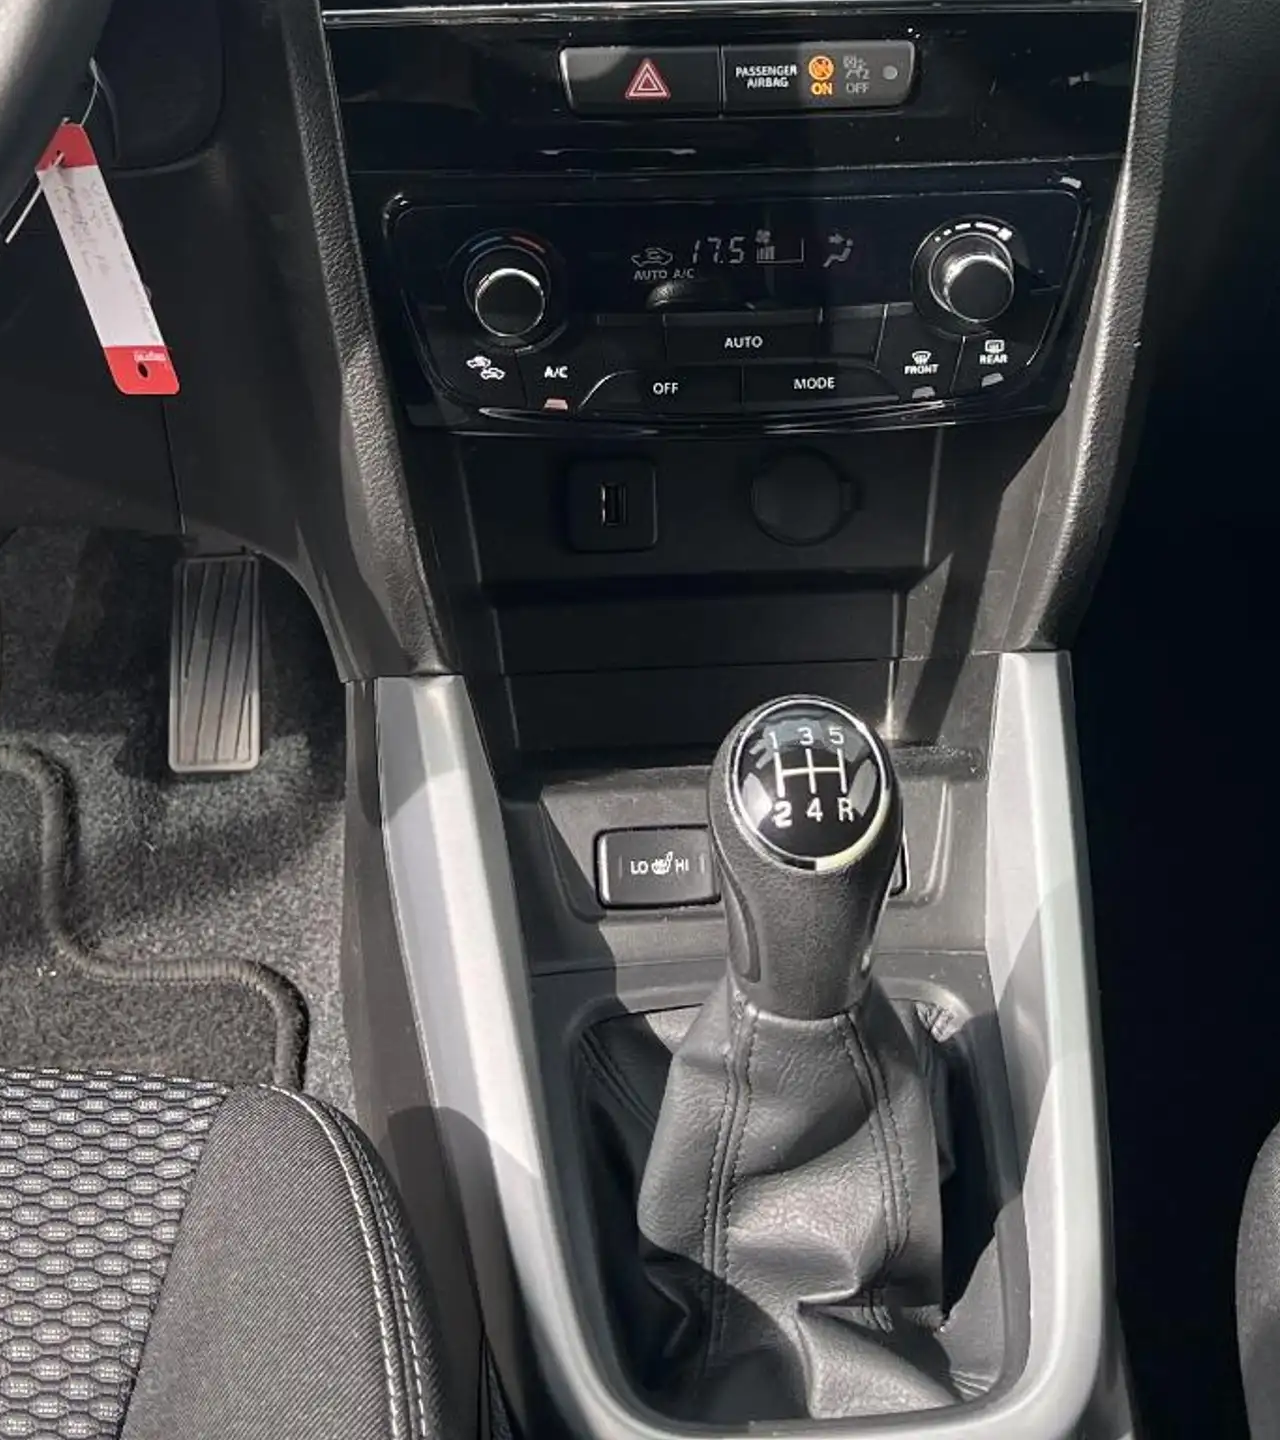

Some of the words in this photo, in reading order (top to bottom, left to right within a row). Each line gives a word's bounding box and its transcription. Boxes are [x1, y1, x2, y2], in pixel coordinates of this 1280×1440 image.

[735, 64, 798, 77] PASSENGER
[747, 76, 789, 89] AIRBAG
[811, 82, 833, 95] ON
[846, 82, 870, 94] OFF
[692, 236, 745, 264] 17.5
[634, 269, 668, 280] AUTO
[672, 268, 695, 279] A/C
[724, 336, 763, 349] AUTO
[980, 354, 1008, 364] REAR
[544, 365, 568, 378] A/C
[904, 364, 939, 375] FRONT
[653, 382, 678, 394] OFF
[793, 375, 836, 390] MODE
[768, 730, 779, 748] 1
[797, 727, 814, 745] 3
[828, 727, 844, 745] 5
[772, 800, 793, 827] 2
[806, 797, 823, 822] 4
[837, 798, 854, 822] R
[630, 860, 649, 875] LO
[675, 858, 690, 872] HI
